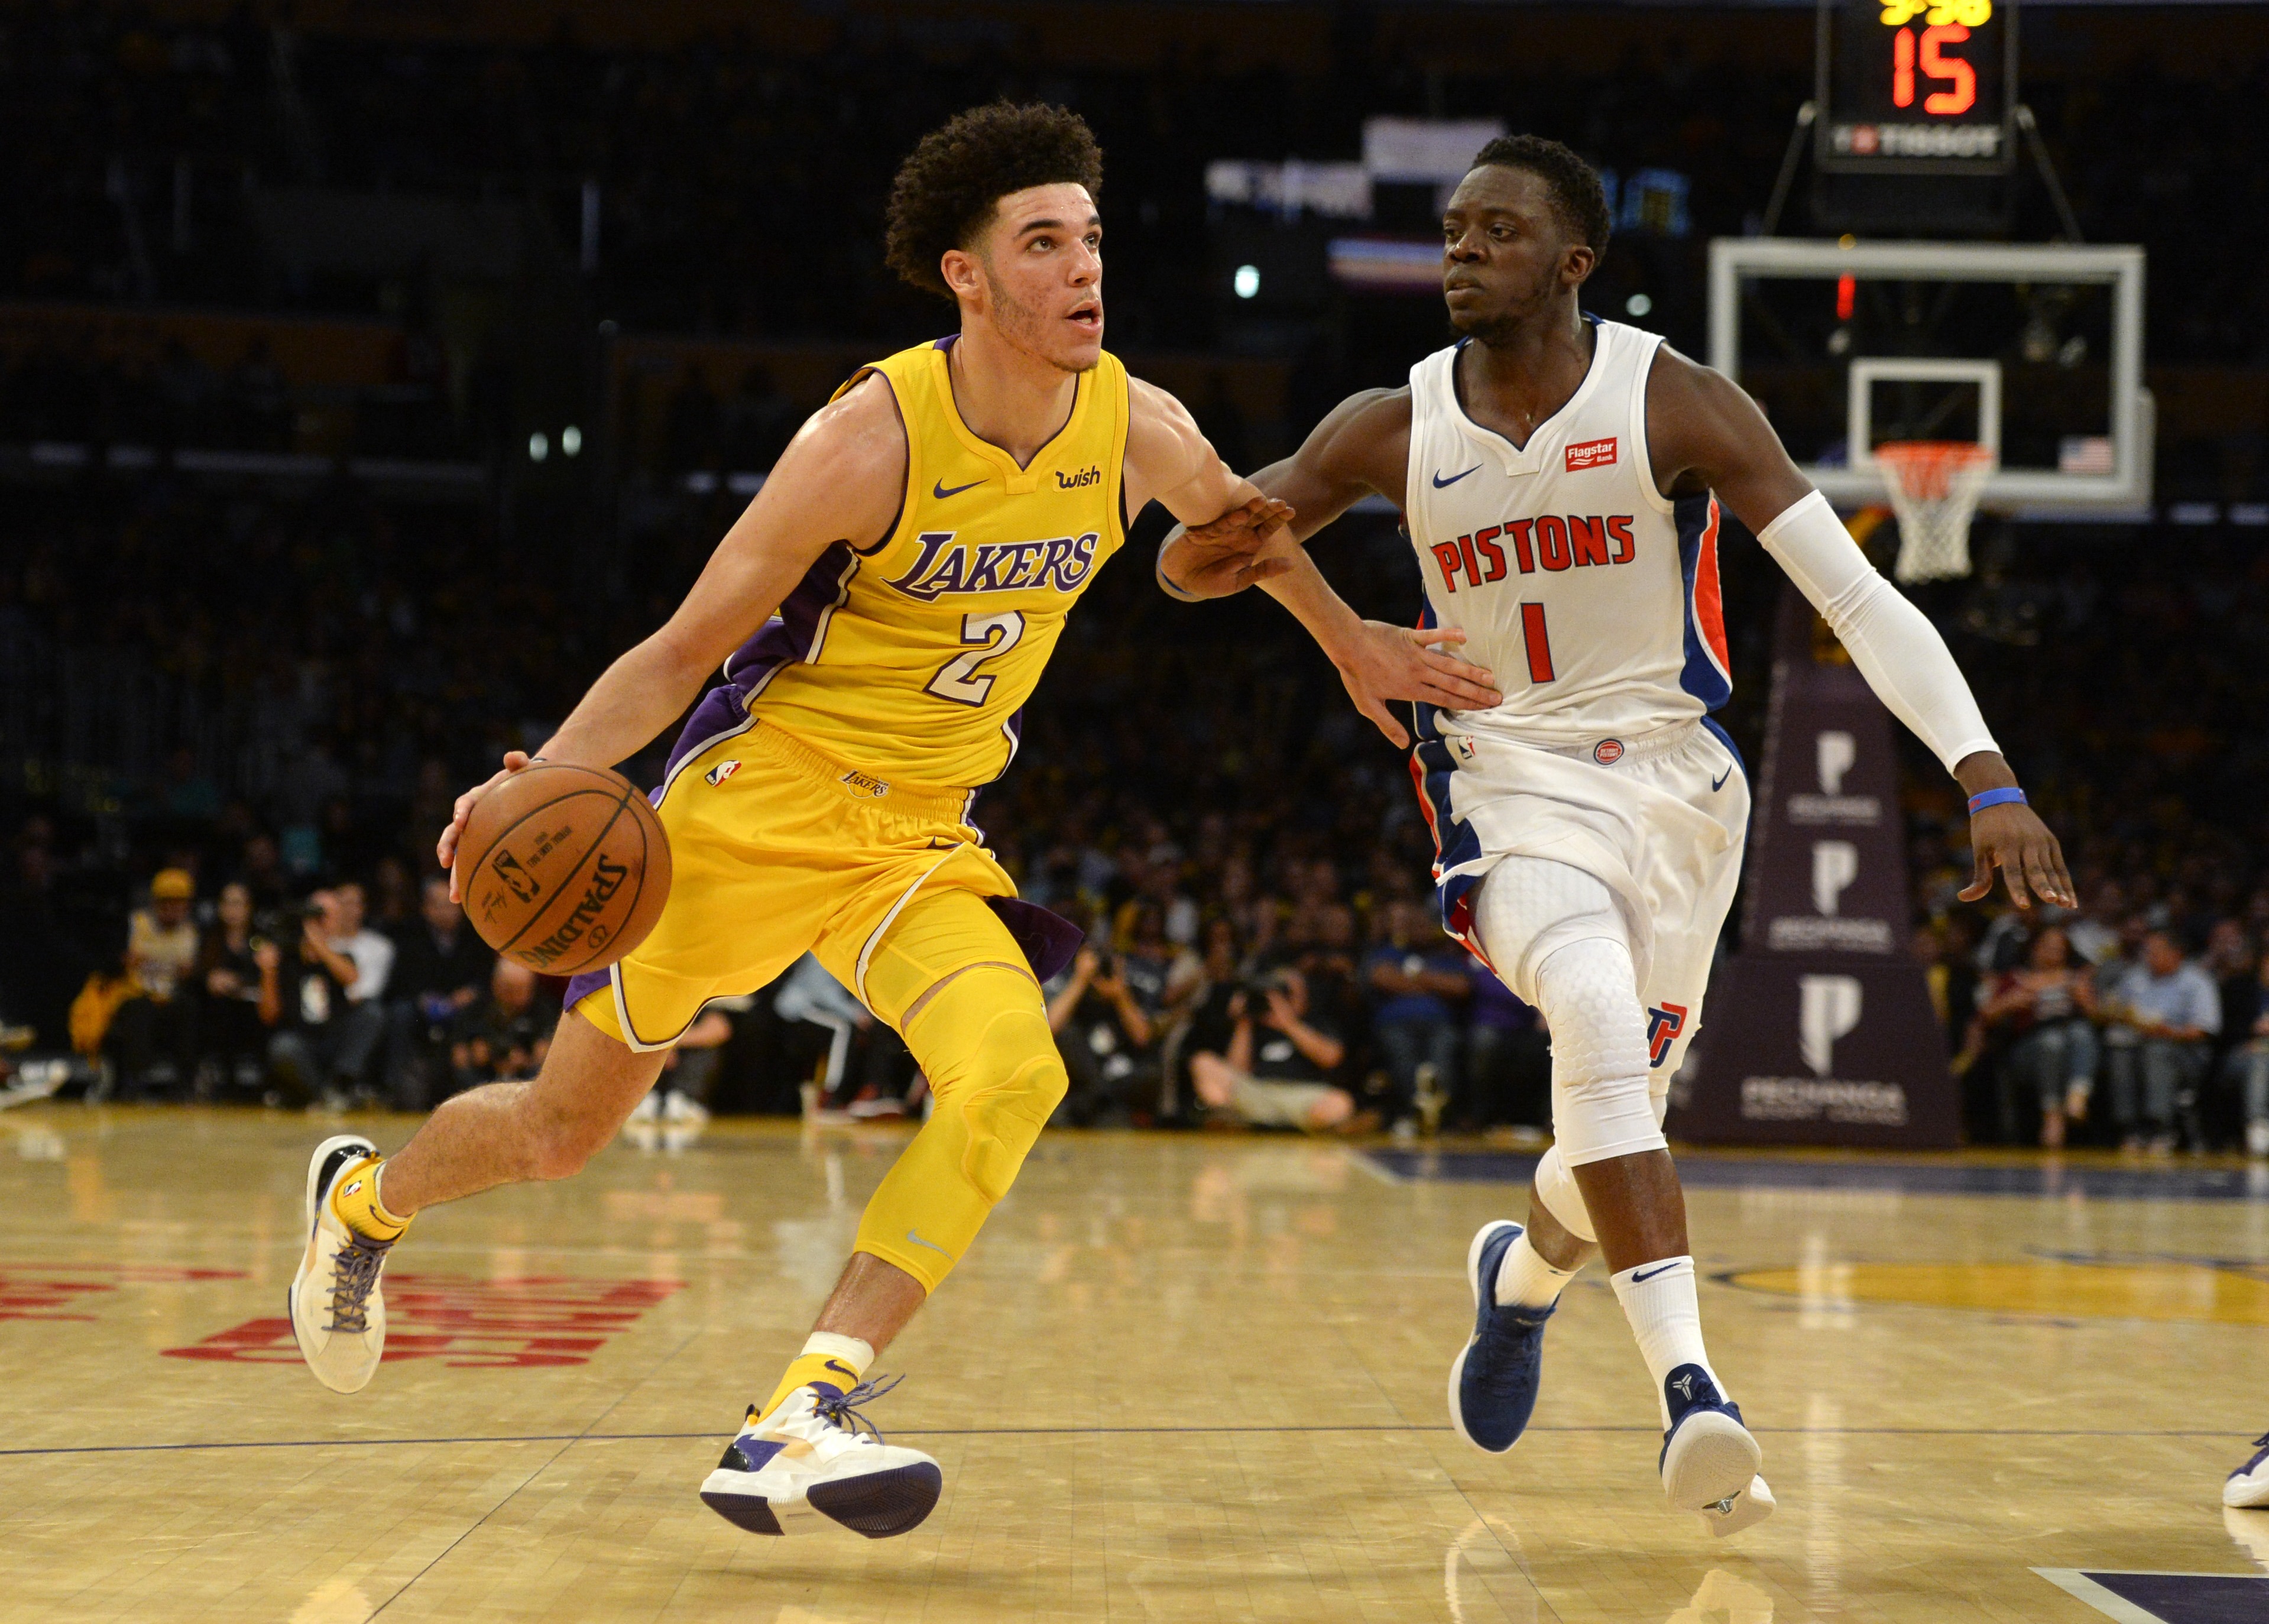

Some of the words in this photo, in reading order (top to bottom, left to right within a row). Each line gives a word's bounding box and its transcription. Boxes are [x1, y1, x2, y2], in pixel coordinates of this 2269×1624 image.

[1893, 24, 1976, 114] 15
[1055, 465, 1100, 488] wish
[1568, 443, 1614, 459] Flagstar
[1597, 454, 1613, 462] Bank
[879, 531, 1100, 603] LAKERS
[1430, 515, 1635, 594] PISTONS
[922, 610, 1026, 708] 2
[1520, 602, 1556, 684] 1
[841, 770, 888, 797] LAKERS
[513, 854, 627, 968] SPALDING
